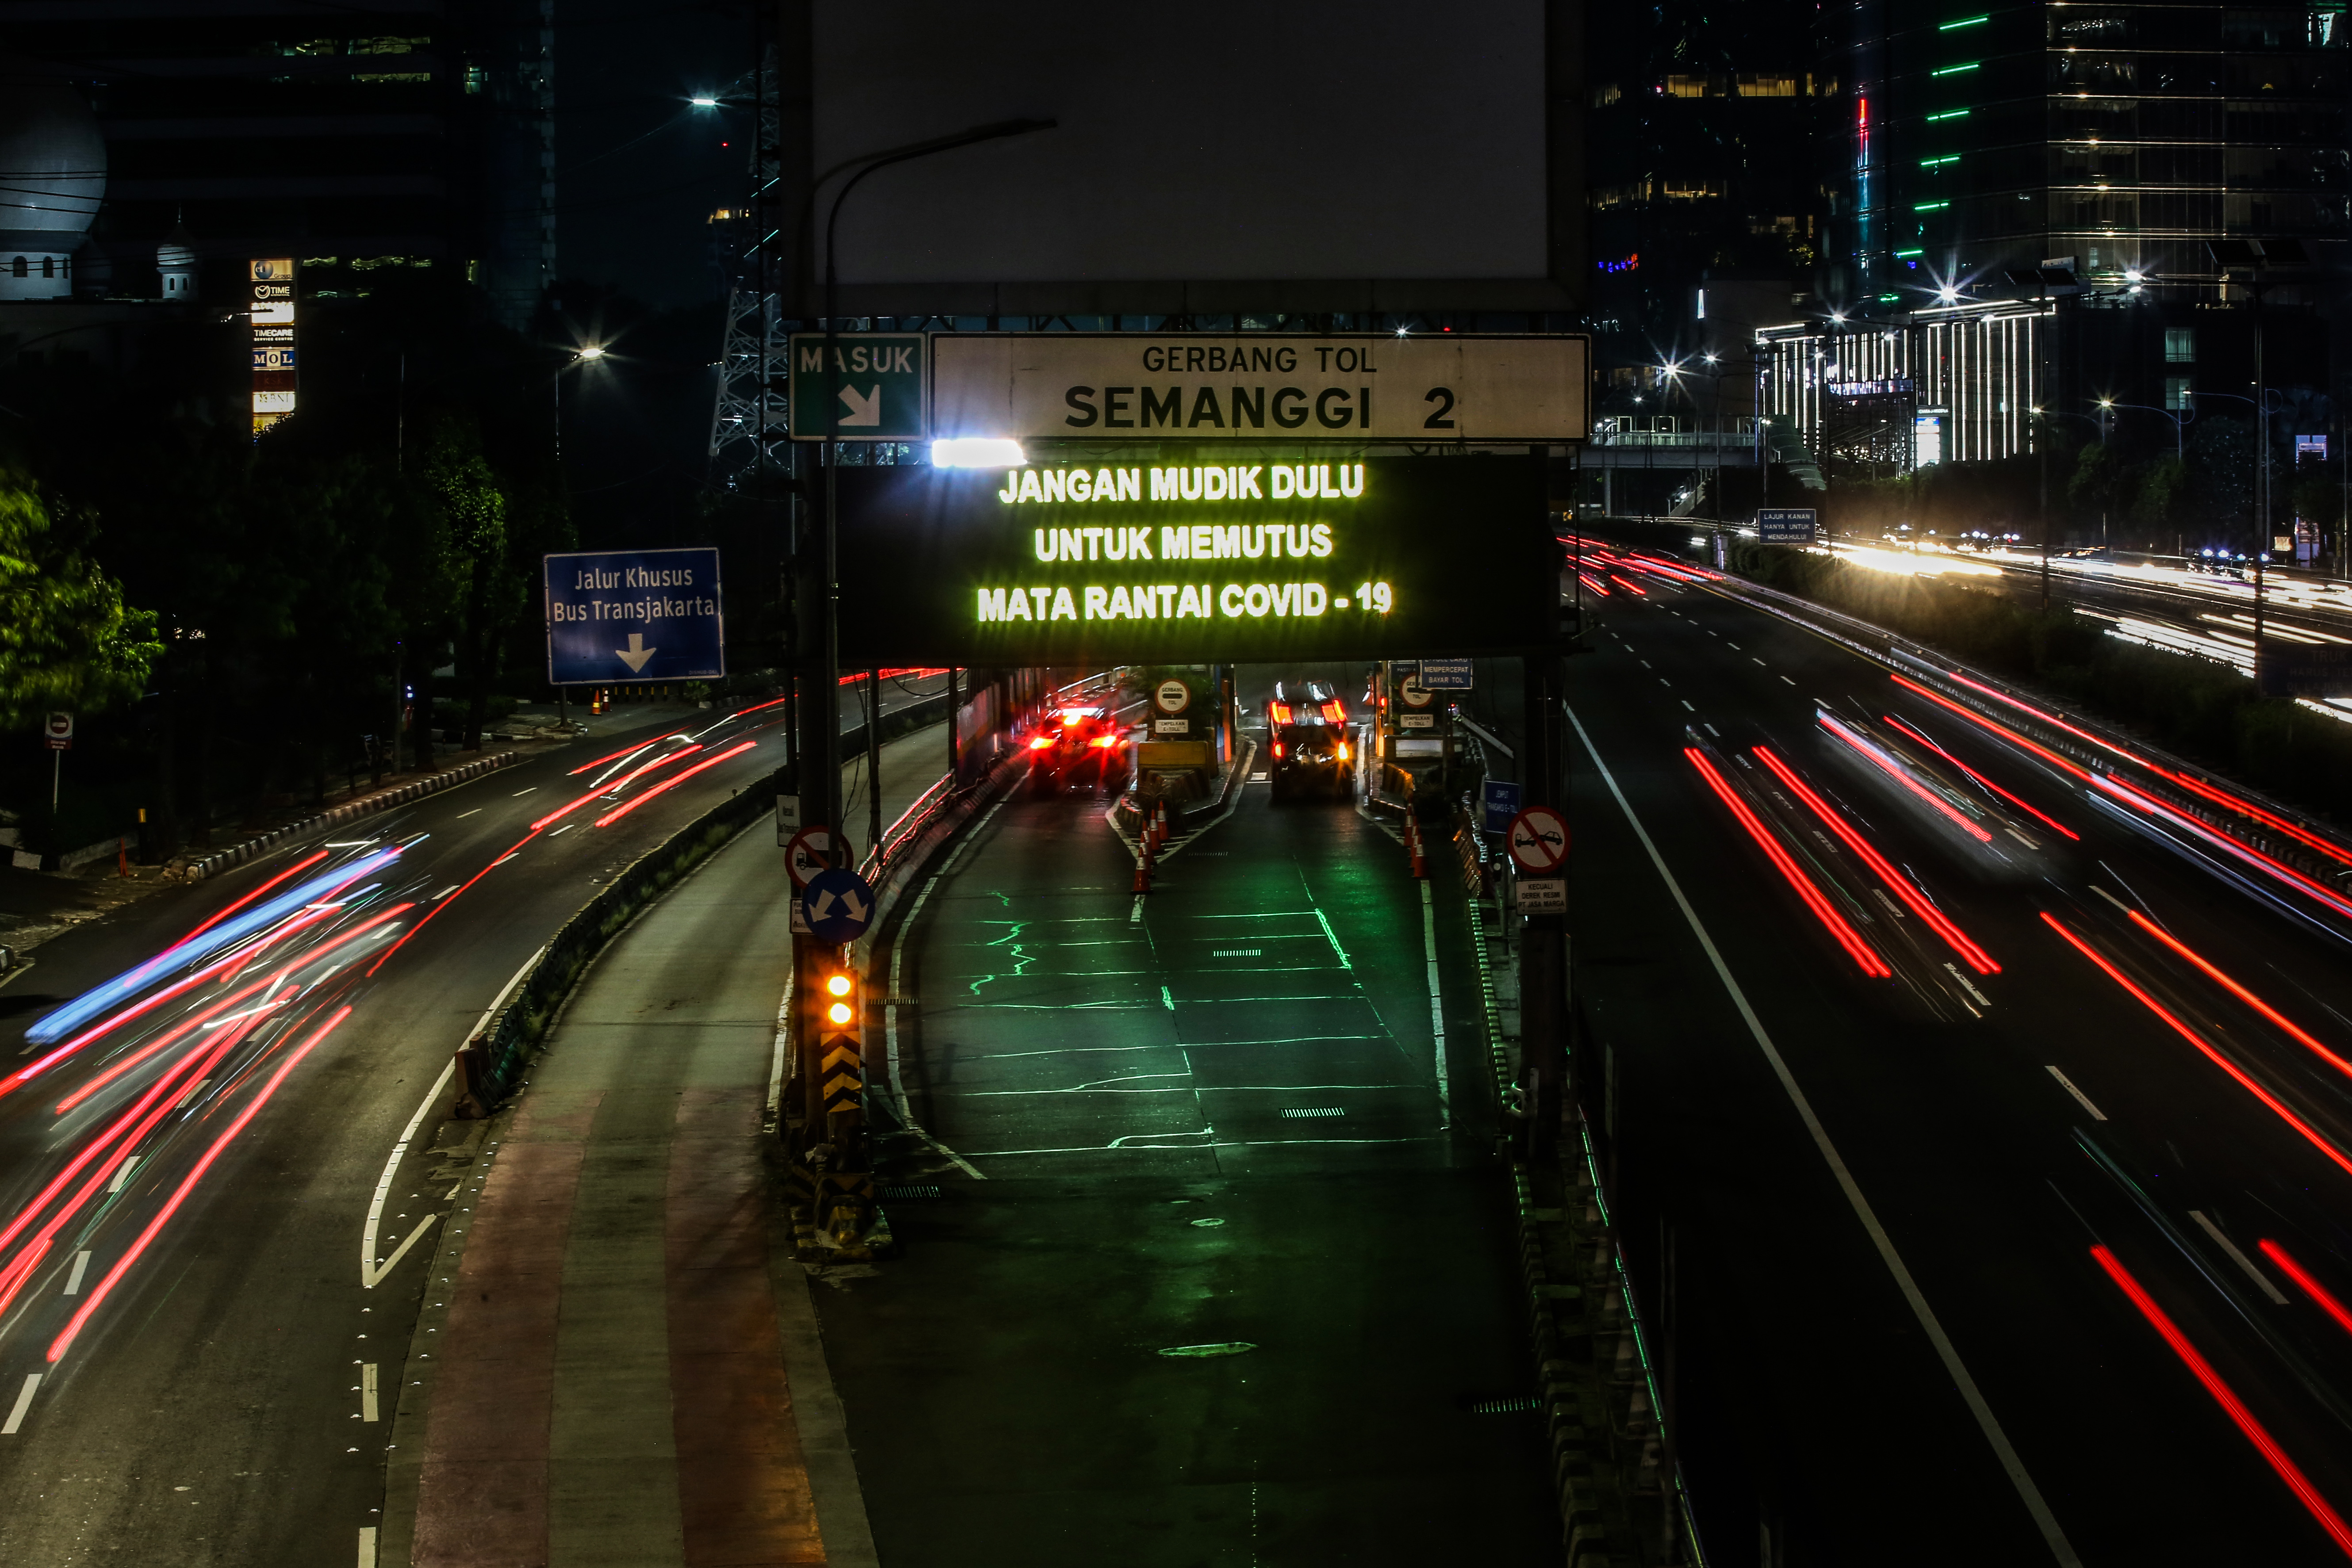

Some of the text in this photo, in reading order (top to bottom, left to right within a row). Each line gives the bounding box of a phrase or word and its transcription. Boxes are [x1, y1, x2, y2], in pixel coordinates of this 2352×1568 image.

[254, 354, 292, 364] MOL
[801, 346, 913, 373] MASUK
[1142, 346, 1377, 374] GERBANG TOL
[1065, 386, 1455, 429] SEMANGGI 2
[999, 464, 1364, 503] JANGAN MUDIK DULU
[1035, 524, 1333, 561] UNTUK MEMUTUS
[575, 566, 693, 590] Jalur Khusus
[554, 597, 714, 623] Bus Transjakarta
[978, 587, 1076, 621] MATA
[1085, 584, 1211, 619] RANTAI
[1220, 583, 1326, 617] COVID
[1356, 581, 1392, 613] 19
